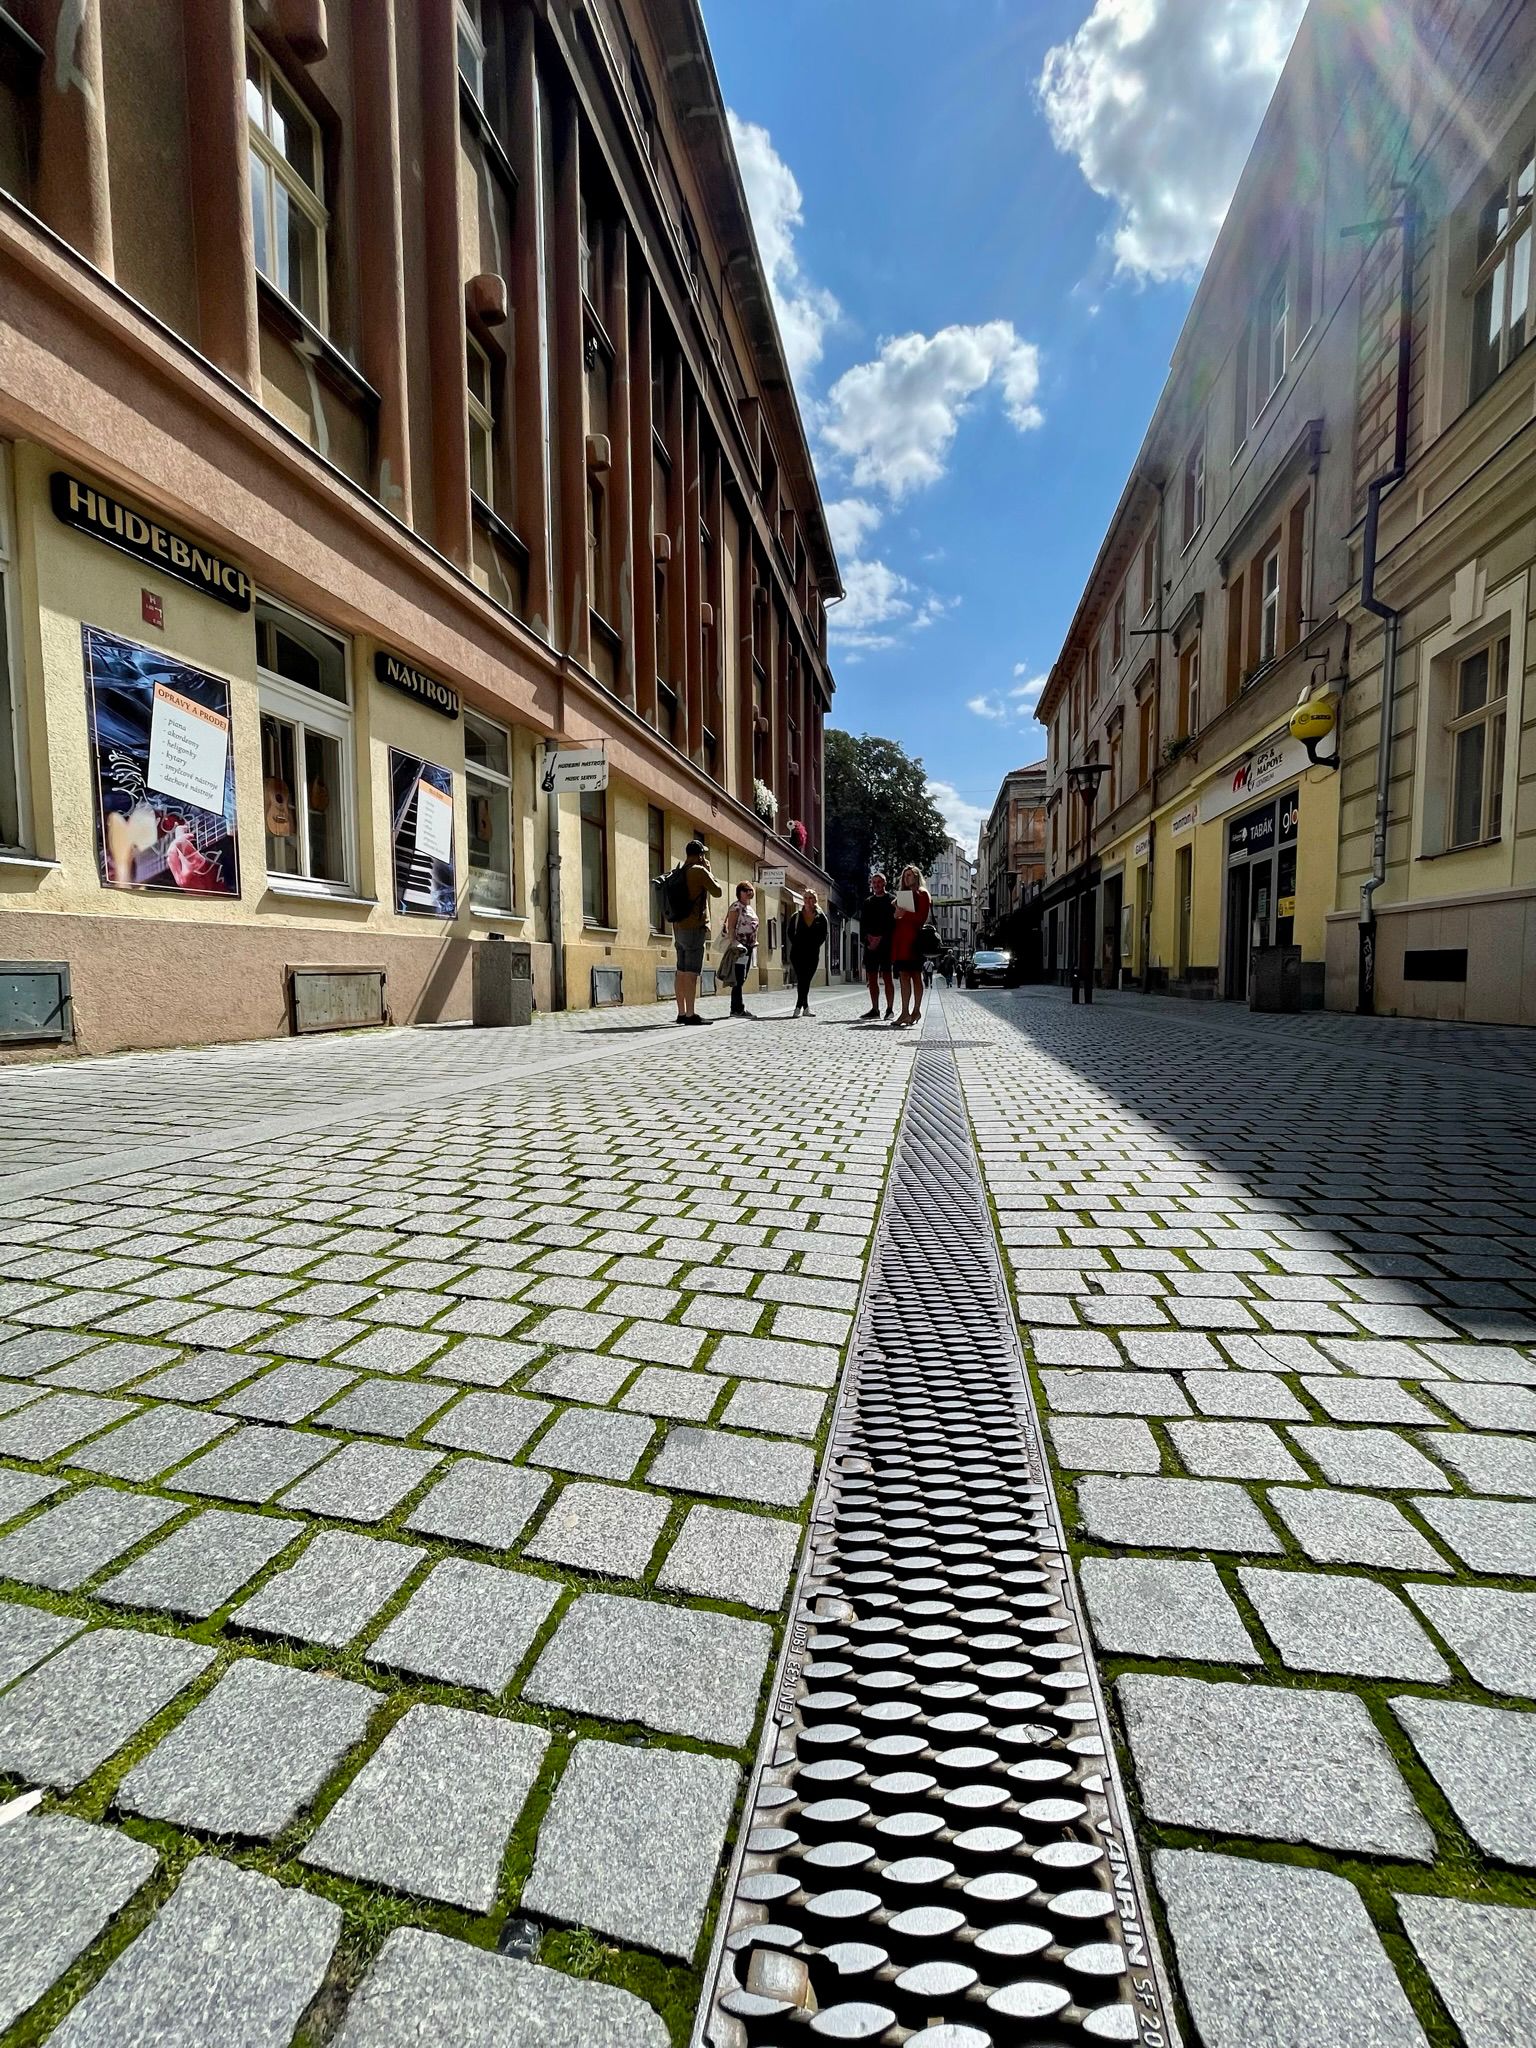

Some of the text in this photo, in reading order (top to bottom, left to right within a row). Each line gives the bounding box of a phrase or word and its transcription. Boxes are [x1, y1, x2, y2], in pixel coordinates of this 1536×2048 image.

[158, 688, 227, 730] OPRAVY A PRODEJ
[167, 719, 187, 732] piana
[165, 750, 187, 767] kytary
[1250, 817, 1273, 840] TABÁK
[778, 1624, 808, 1713] EN 1433 F900
[1132, 1975, 1158, 2012] SF
